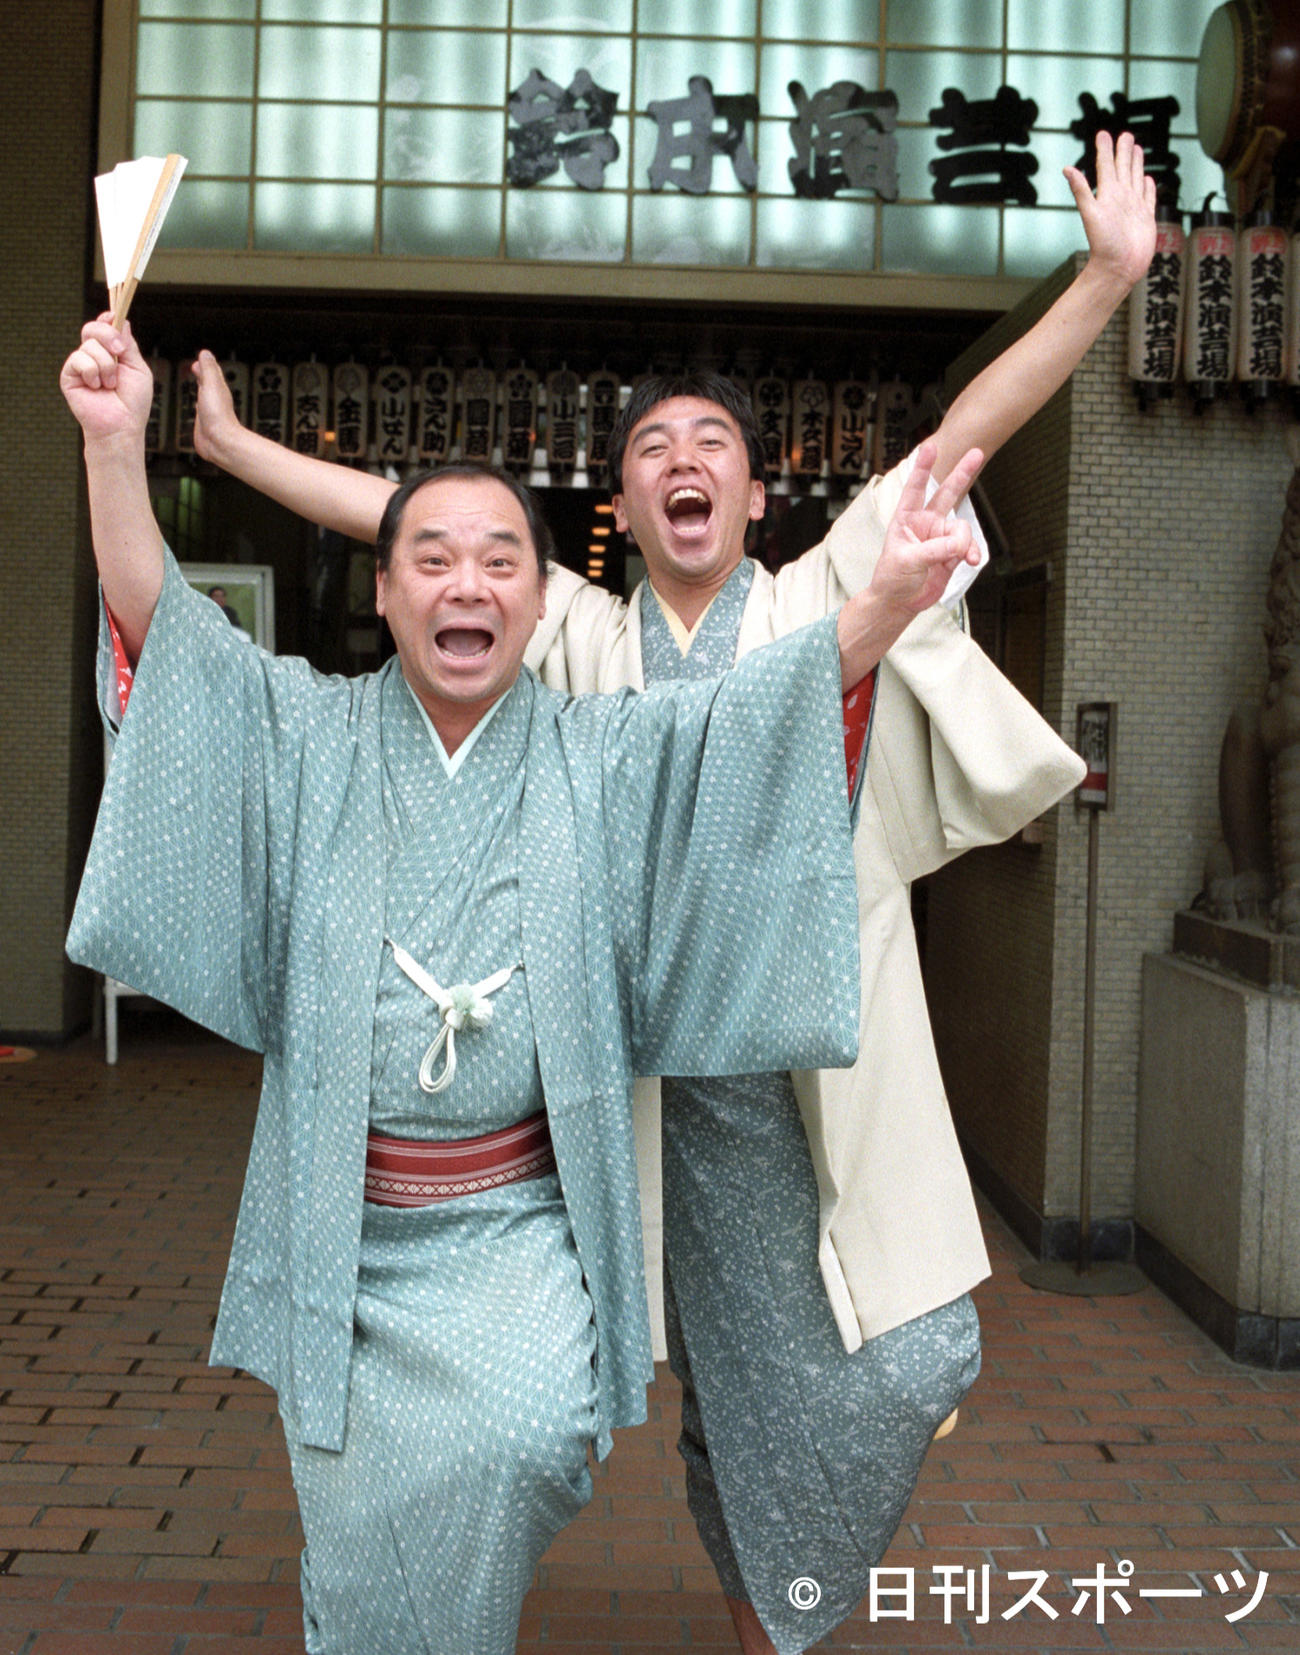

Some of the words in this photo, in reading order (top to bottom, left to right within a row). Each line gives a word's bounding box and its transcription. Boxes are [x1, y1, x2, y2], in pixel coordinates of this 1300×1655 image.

[1144, 252, 1181, 379] 鈴本演芸場
[1197, 255, 1231, 378] 鈴本演芸場
[1250, 253, 1284, 377] 鈴本演芸場
